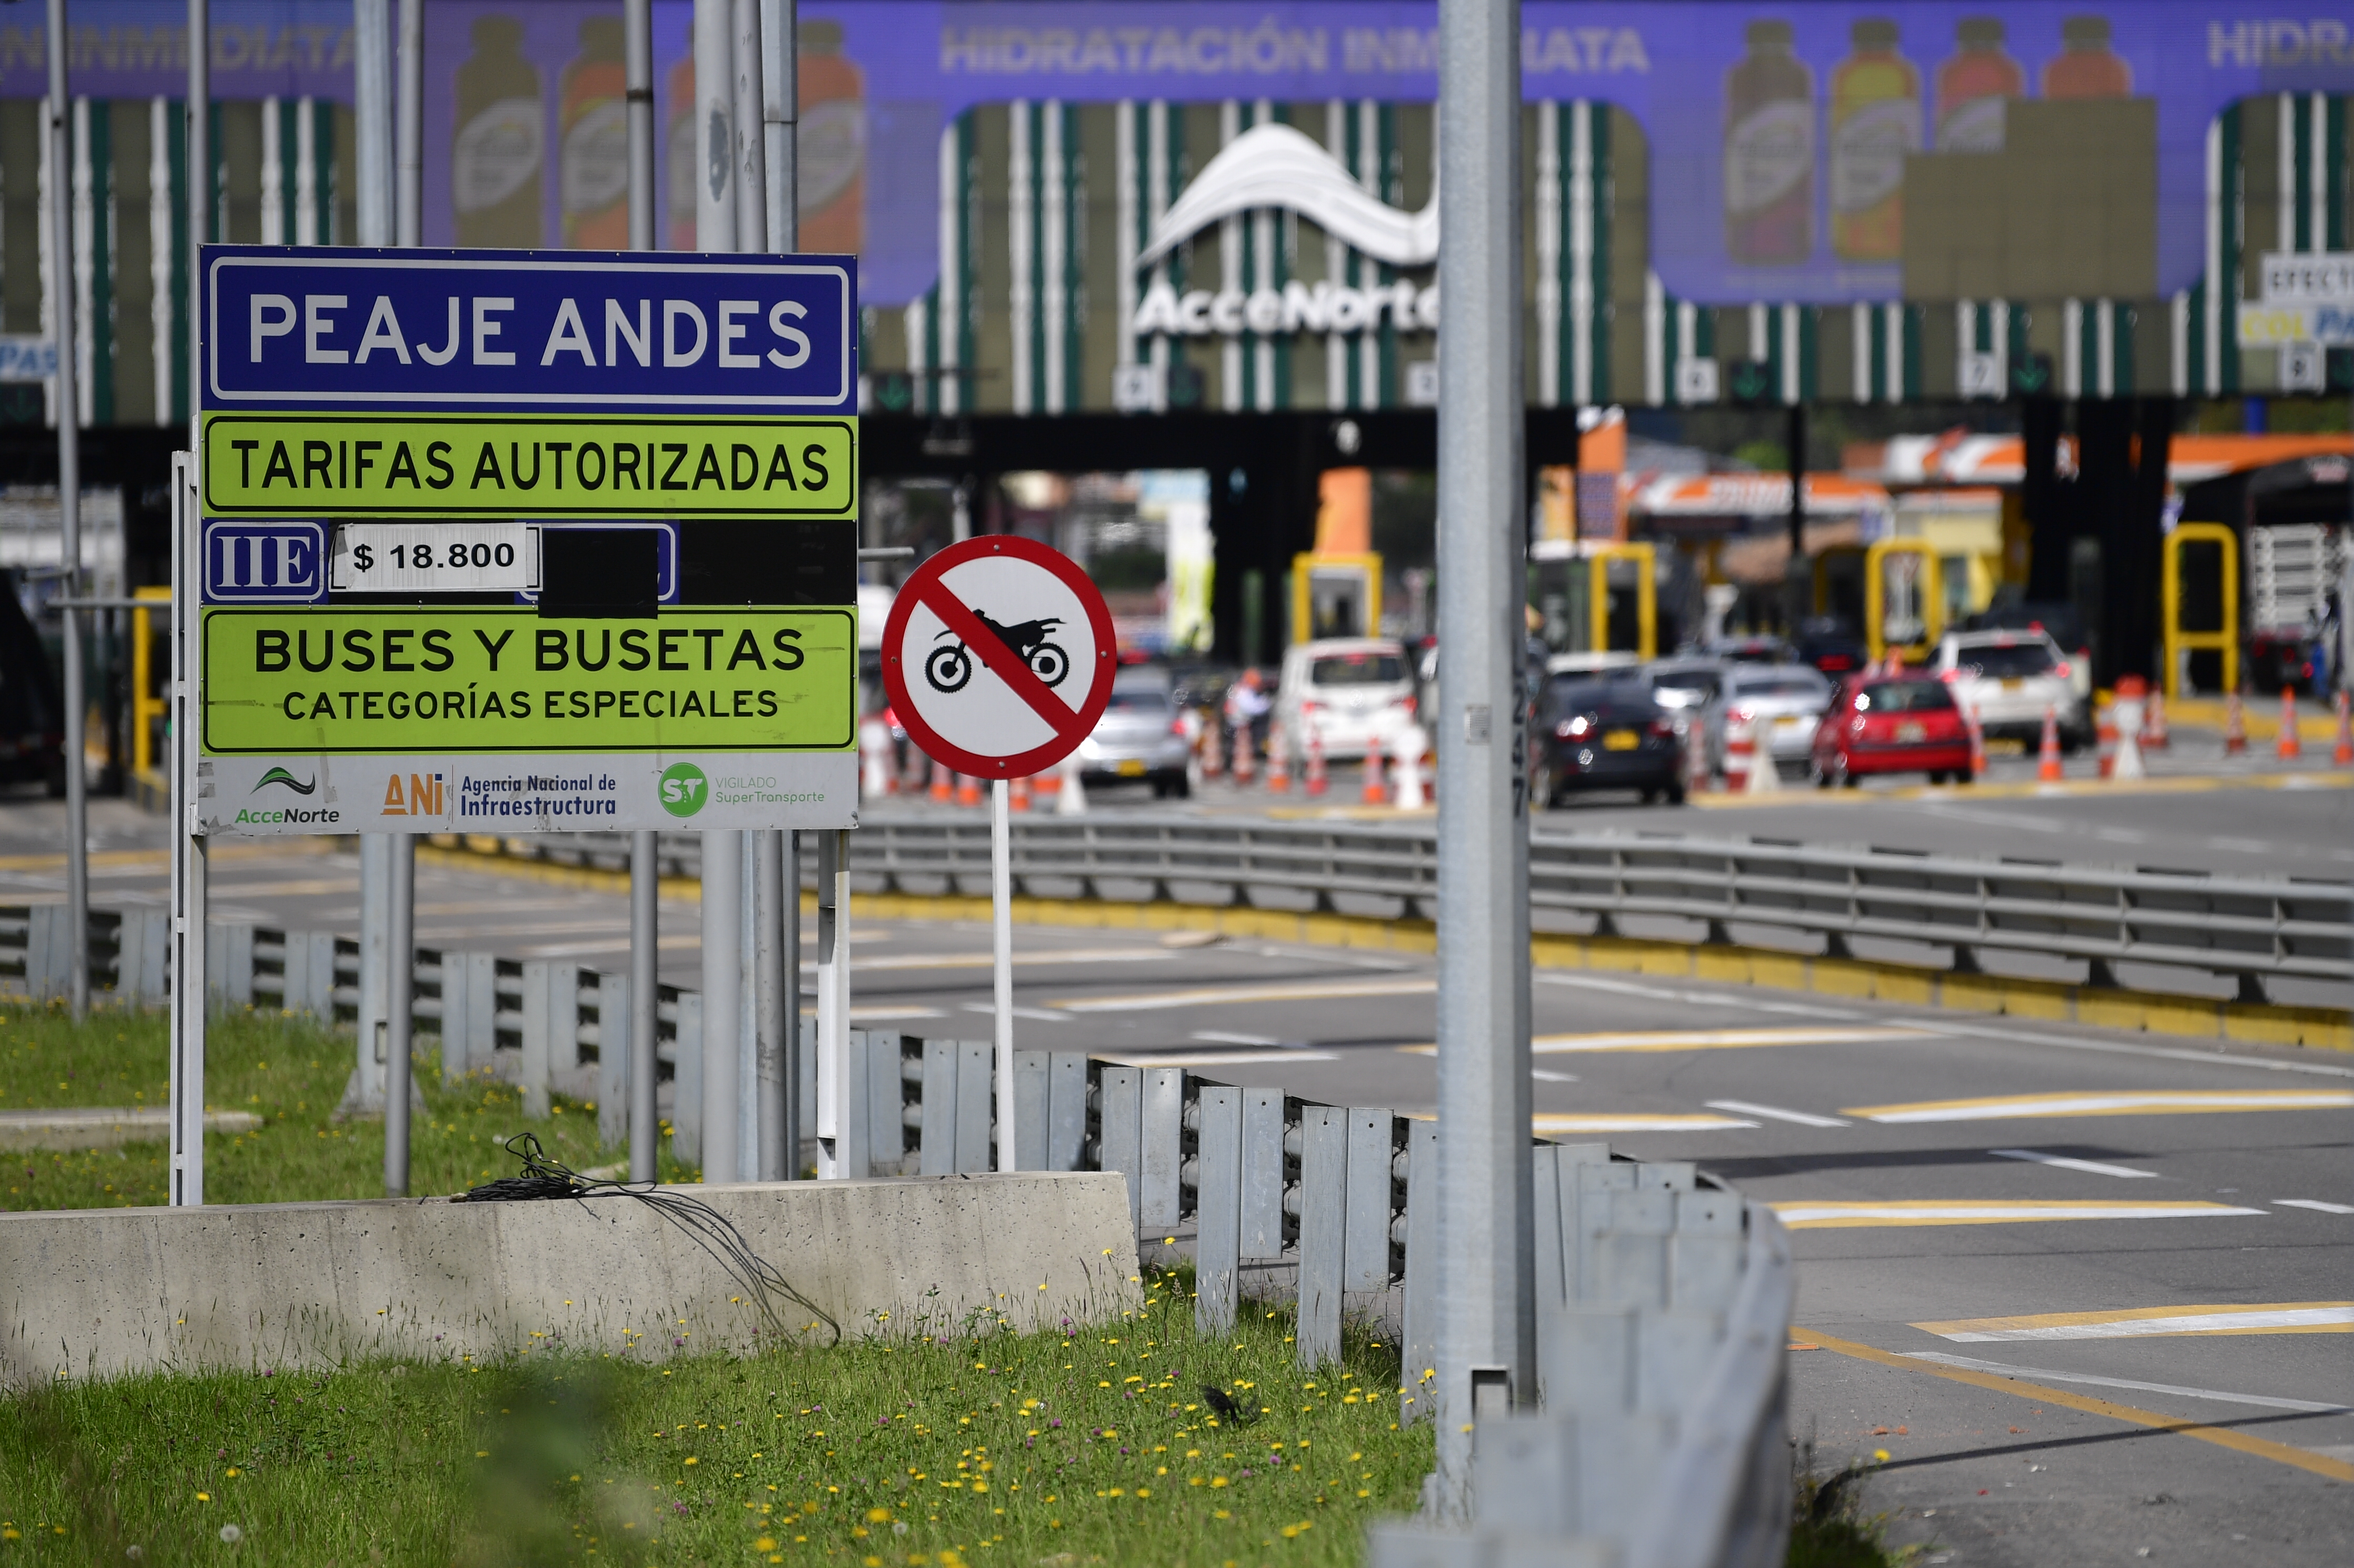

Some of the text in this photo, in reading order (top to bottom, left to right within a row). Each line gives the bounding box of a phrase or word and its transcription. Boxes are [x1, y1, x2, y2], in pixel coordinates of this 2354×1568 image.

[943, 12, 1325, 74] HIDRATACIÓN
[251, 294, 810, 369] PEAJE ANDES
[232, 440, 828, 491] TARIFAS AUTORIZADAS
[217, 537, 313, 586] IIE
[354, 543, 514, 572] $ 18.800
[256, 629, 804, 672] BUSES Y BUSETAS
[283, 683, 777, 720] CATEGORÍAS ESPECIALES
[461, 774, 615, 796] Agencia Nacional de
[716, 777, 776, 788] VIGILADO
[716, 791, 824, 806] SuperTransporte
[235, 808, 339, 823] AcceNorte
[461, 794, 616, 816] Infraestructura
